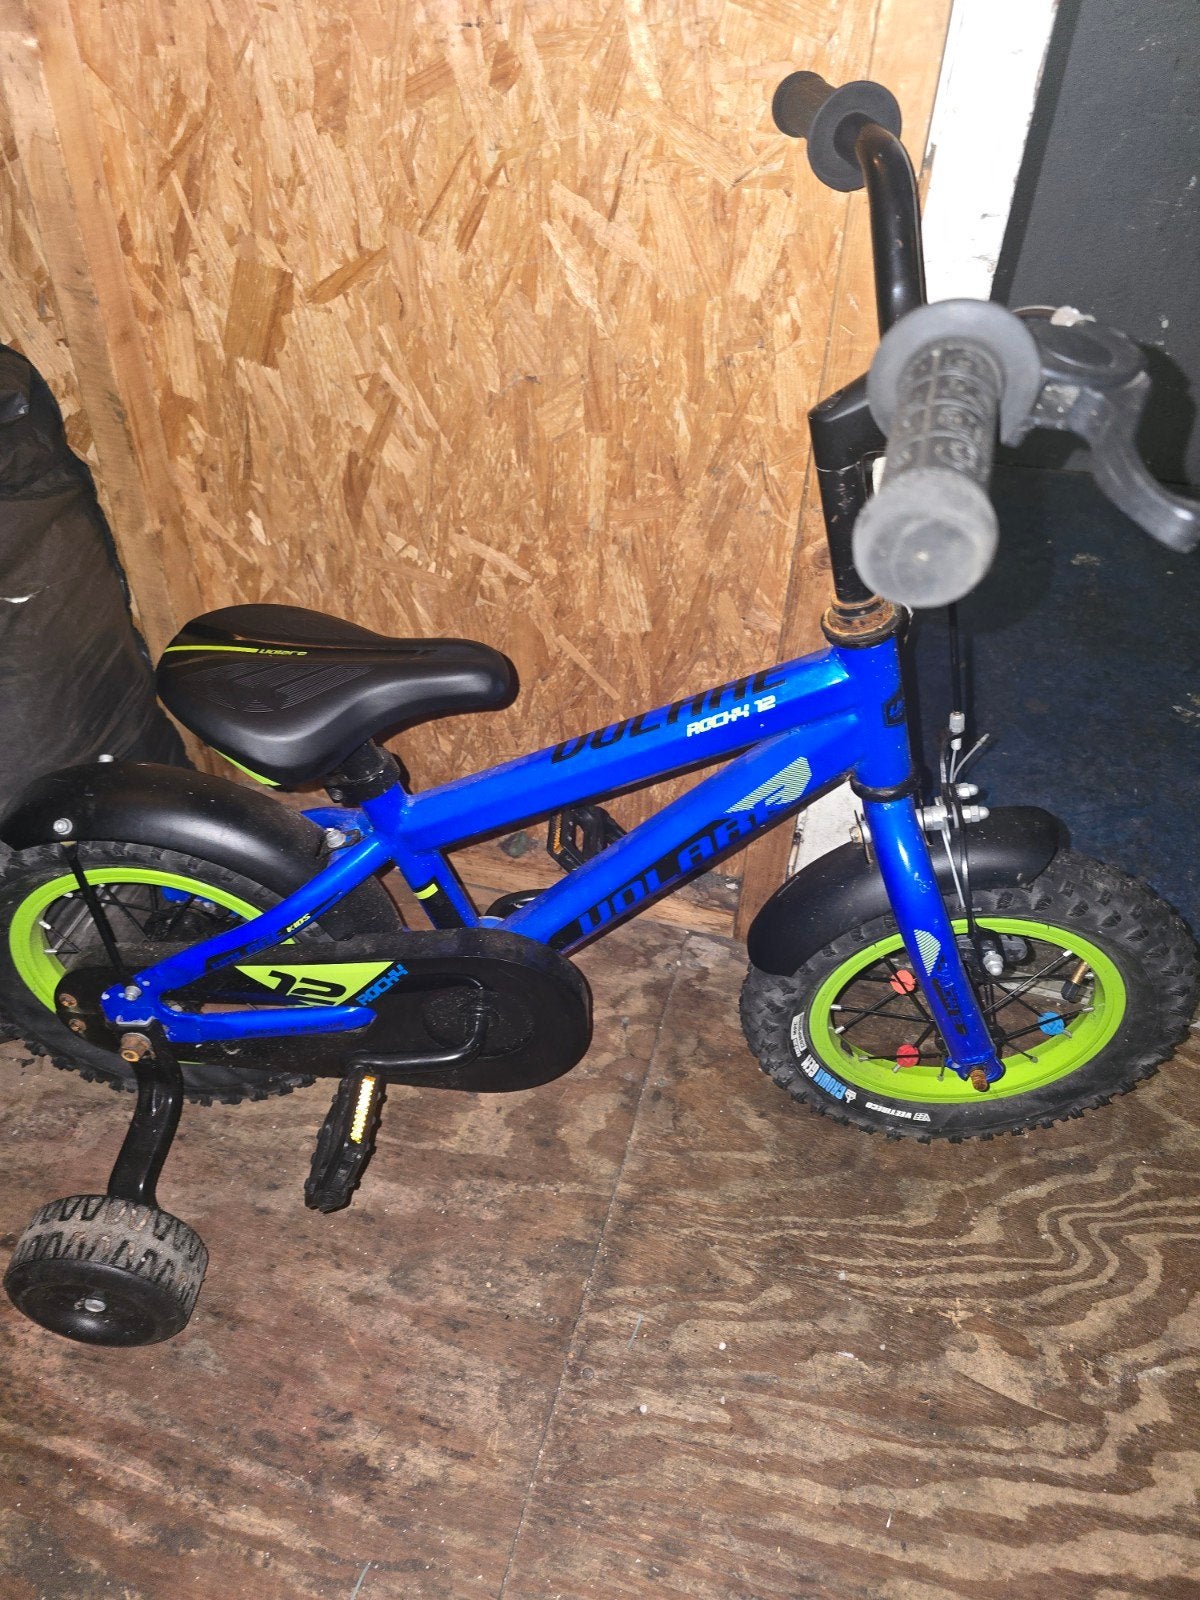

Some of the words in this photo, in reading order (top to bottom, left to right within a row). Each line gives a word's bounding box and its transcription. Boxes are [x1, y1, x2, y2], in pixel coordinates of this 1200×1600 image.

[686, 703, 750, 737] ROCKY
[754, 695, 777, 713] 12
[286, 913, 311, 933] KIDS
[268, 969, 347, 1007] 12
[355, 963, 409, 1007] ROCKY
[800, 1054, 820, 1078] GEM
[813, 1067, 847, 1101] CROWN
